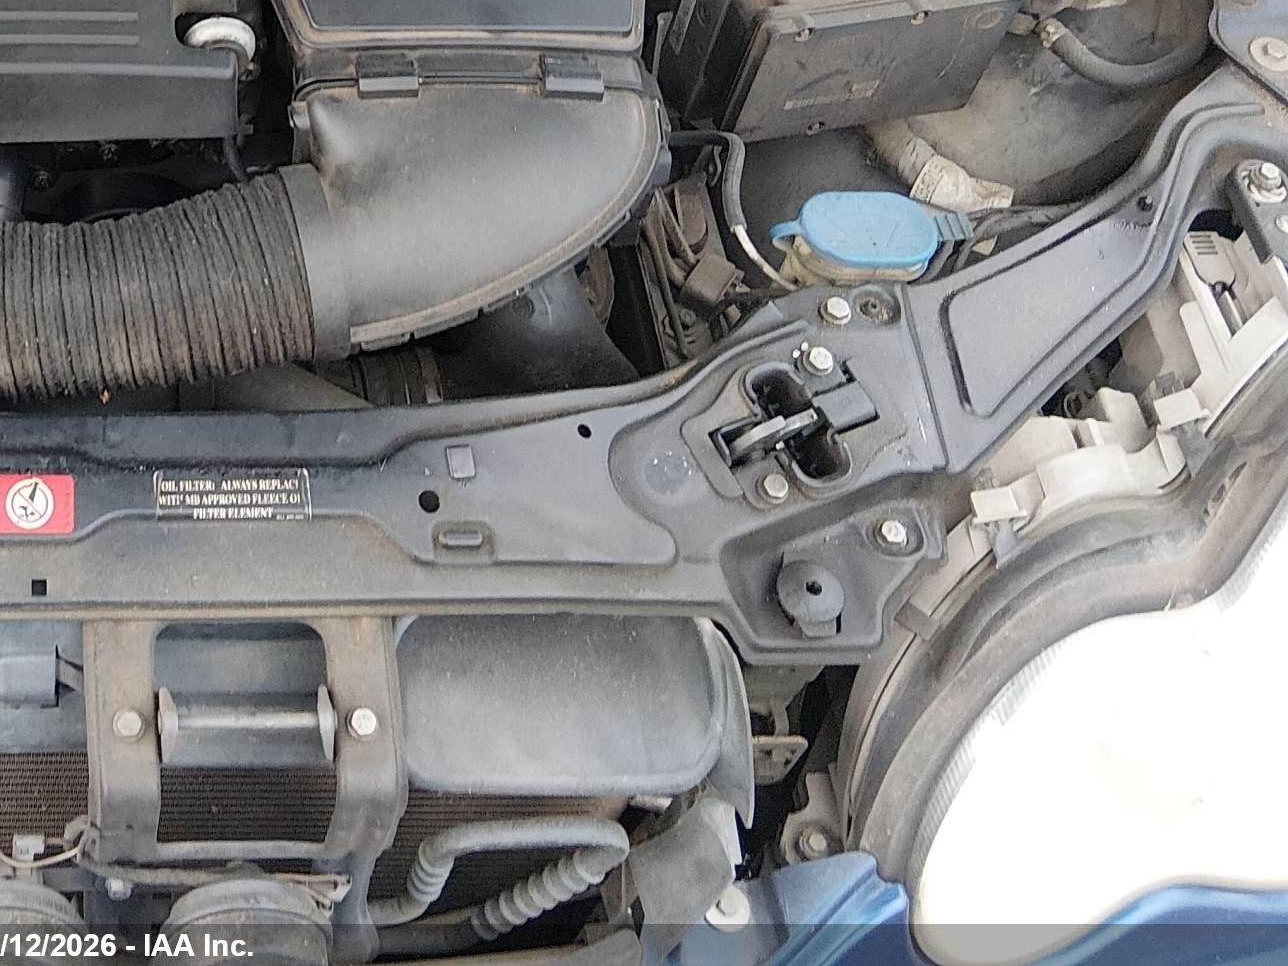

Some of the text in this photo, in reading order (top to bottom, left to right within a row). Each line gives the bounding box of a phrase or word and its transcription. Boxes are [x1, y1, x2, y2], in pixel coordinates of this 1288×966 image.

[161, 479, 178, 492] OIL
[221, 478, 258, 491] ALWAYS
[185, 493, 201, 506] MB
[202, 493, 251, 506] APPROVED
[252, 492, 289, 505] FLEECE
[193, 507, 227, 519] FILTER
[228, 507, 273, 519] ELEMENT
